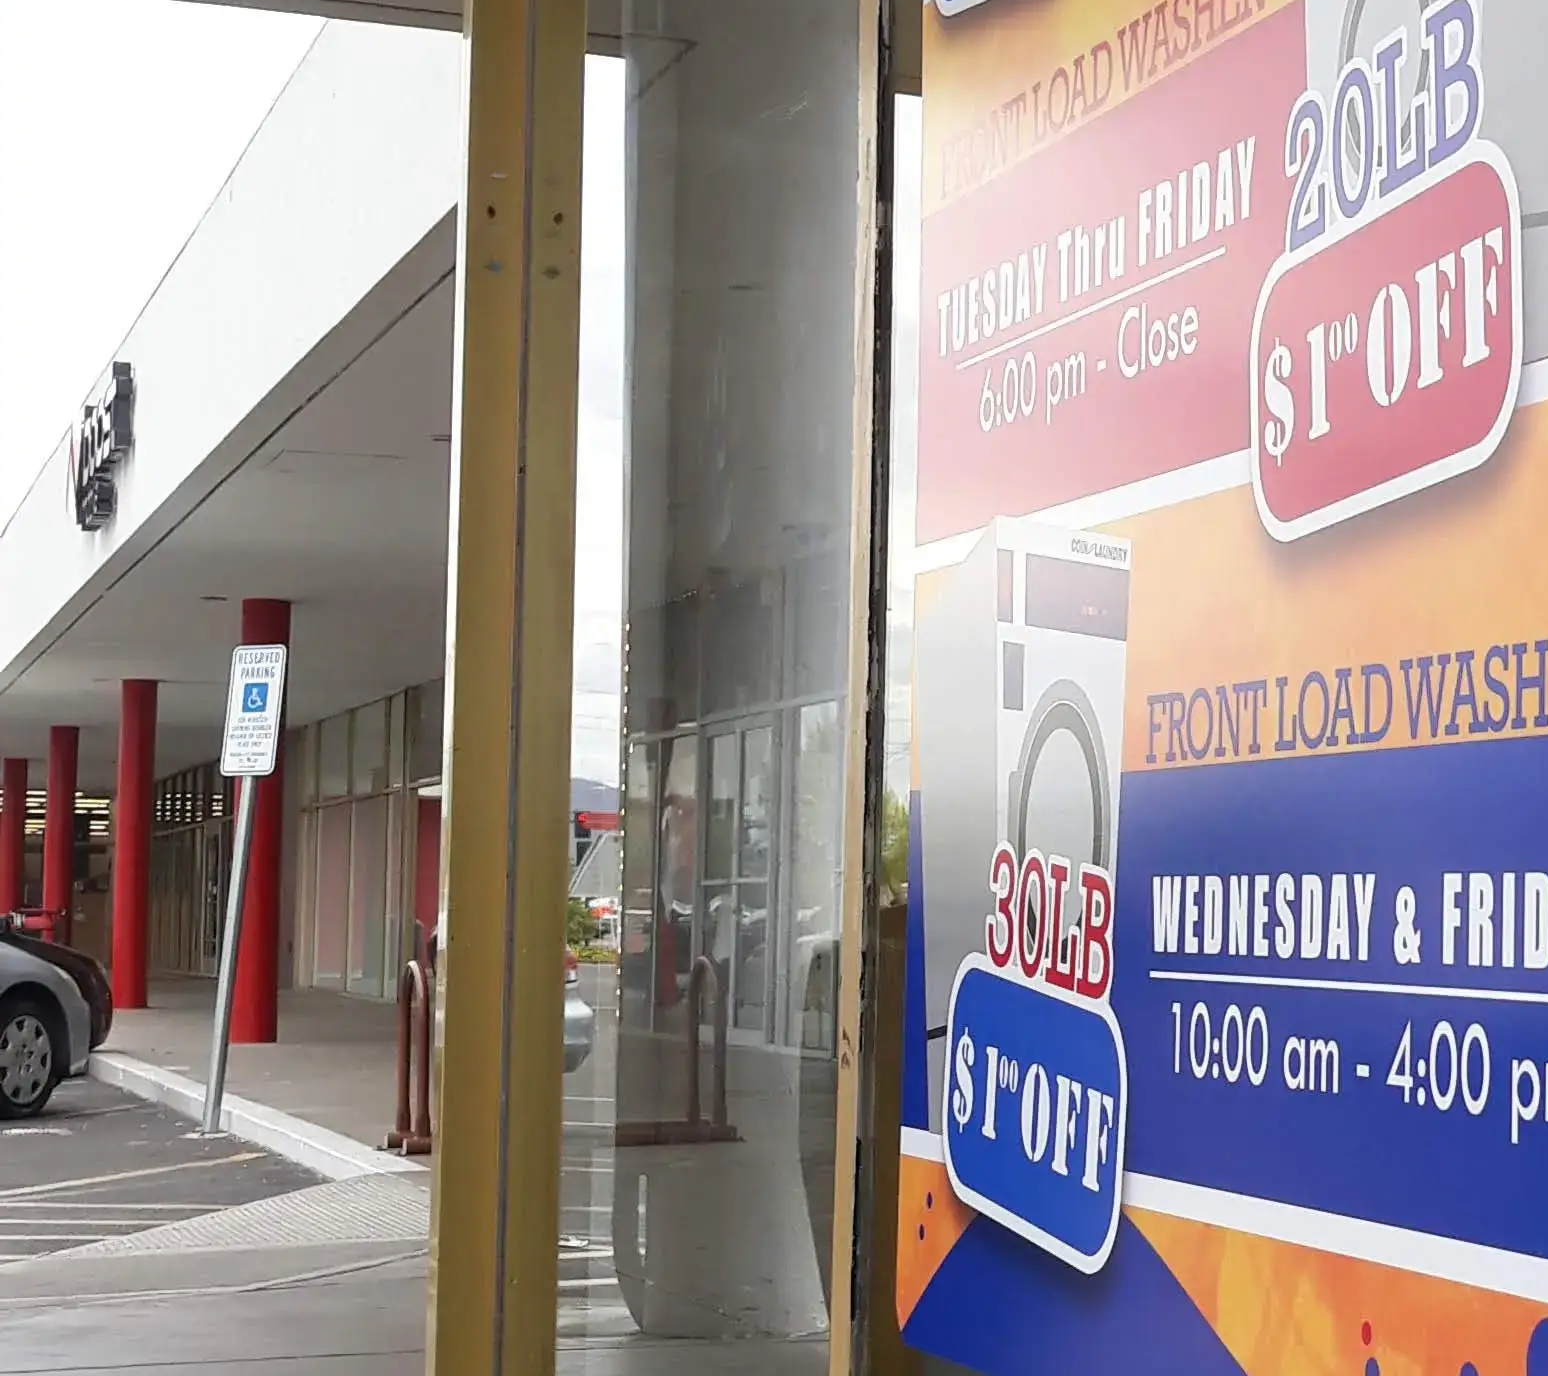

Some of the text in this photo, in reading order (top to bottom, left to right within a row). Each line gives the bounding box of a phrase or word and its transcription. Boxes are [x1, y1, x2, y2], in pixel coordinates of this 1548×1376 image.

[1030, 36, 1114, 153] LOAD
[937, 136, 1258, 358] TUESDAY Thru FRIDAY
[979, 348, 1036, 432] 6:00
[1045, 346, 1088, 426] pm
[1117, 304, 1199, 380] Close
[1366, 226, 1504, 407] OFF
[240, 666, 276, 681] PARKING
[1145, 679, 1271, 764] FRONT
[1274, 663, 1395, 752] LOAD
[986, 849, 1113, 1000] 30LB
[1151, 872, 1377, 963] WEDNESDAY
[1393, 885, 1422, 966] &
[1170, 1001, 1270, 1085] 10:00
[1282, 1040, 1340, 1094] am
[1386, 1020, 1491, 1115] 4:00
[1019, 1061, 1115, 1194] OFF
